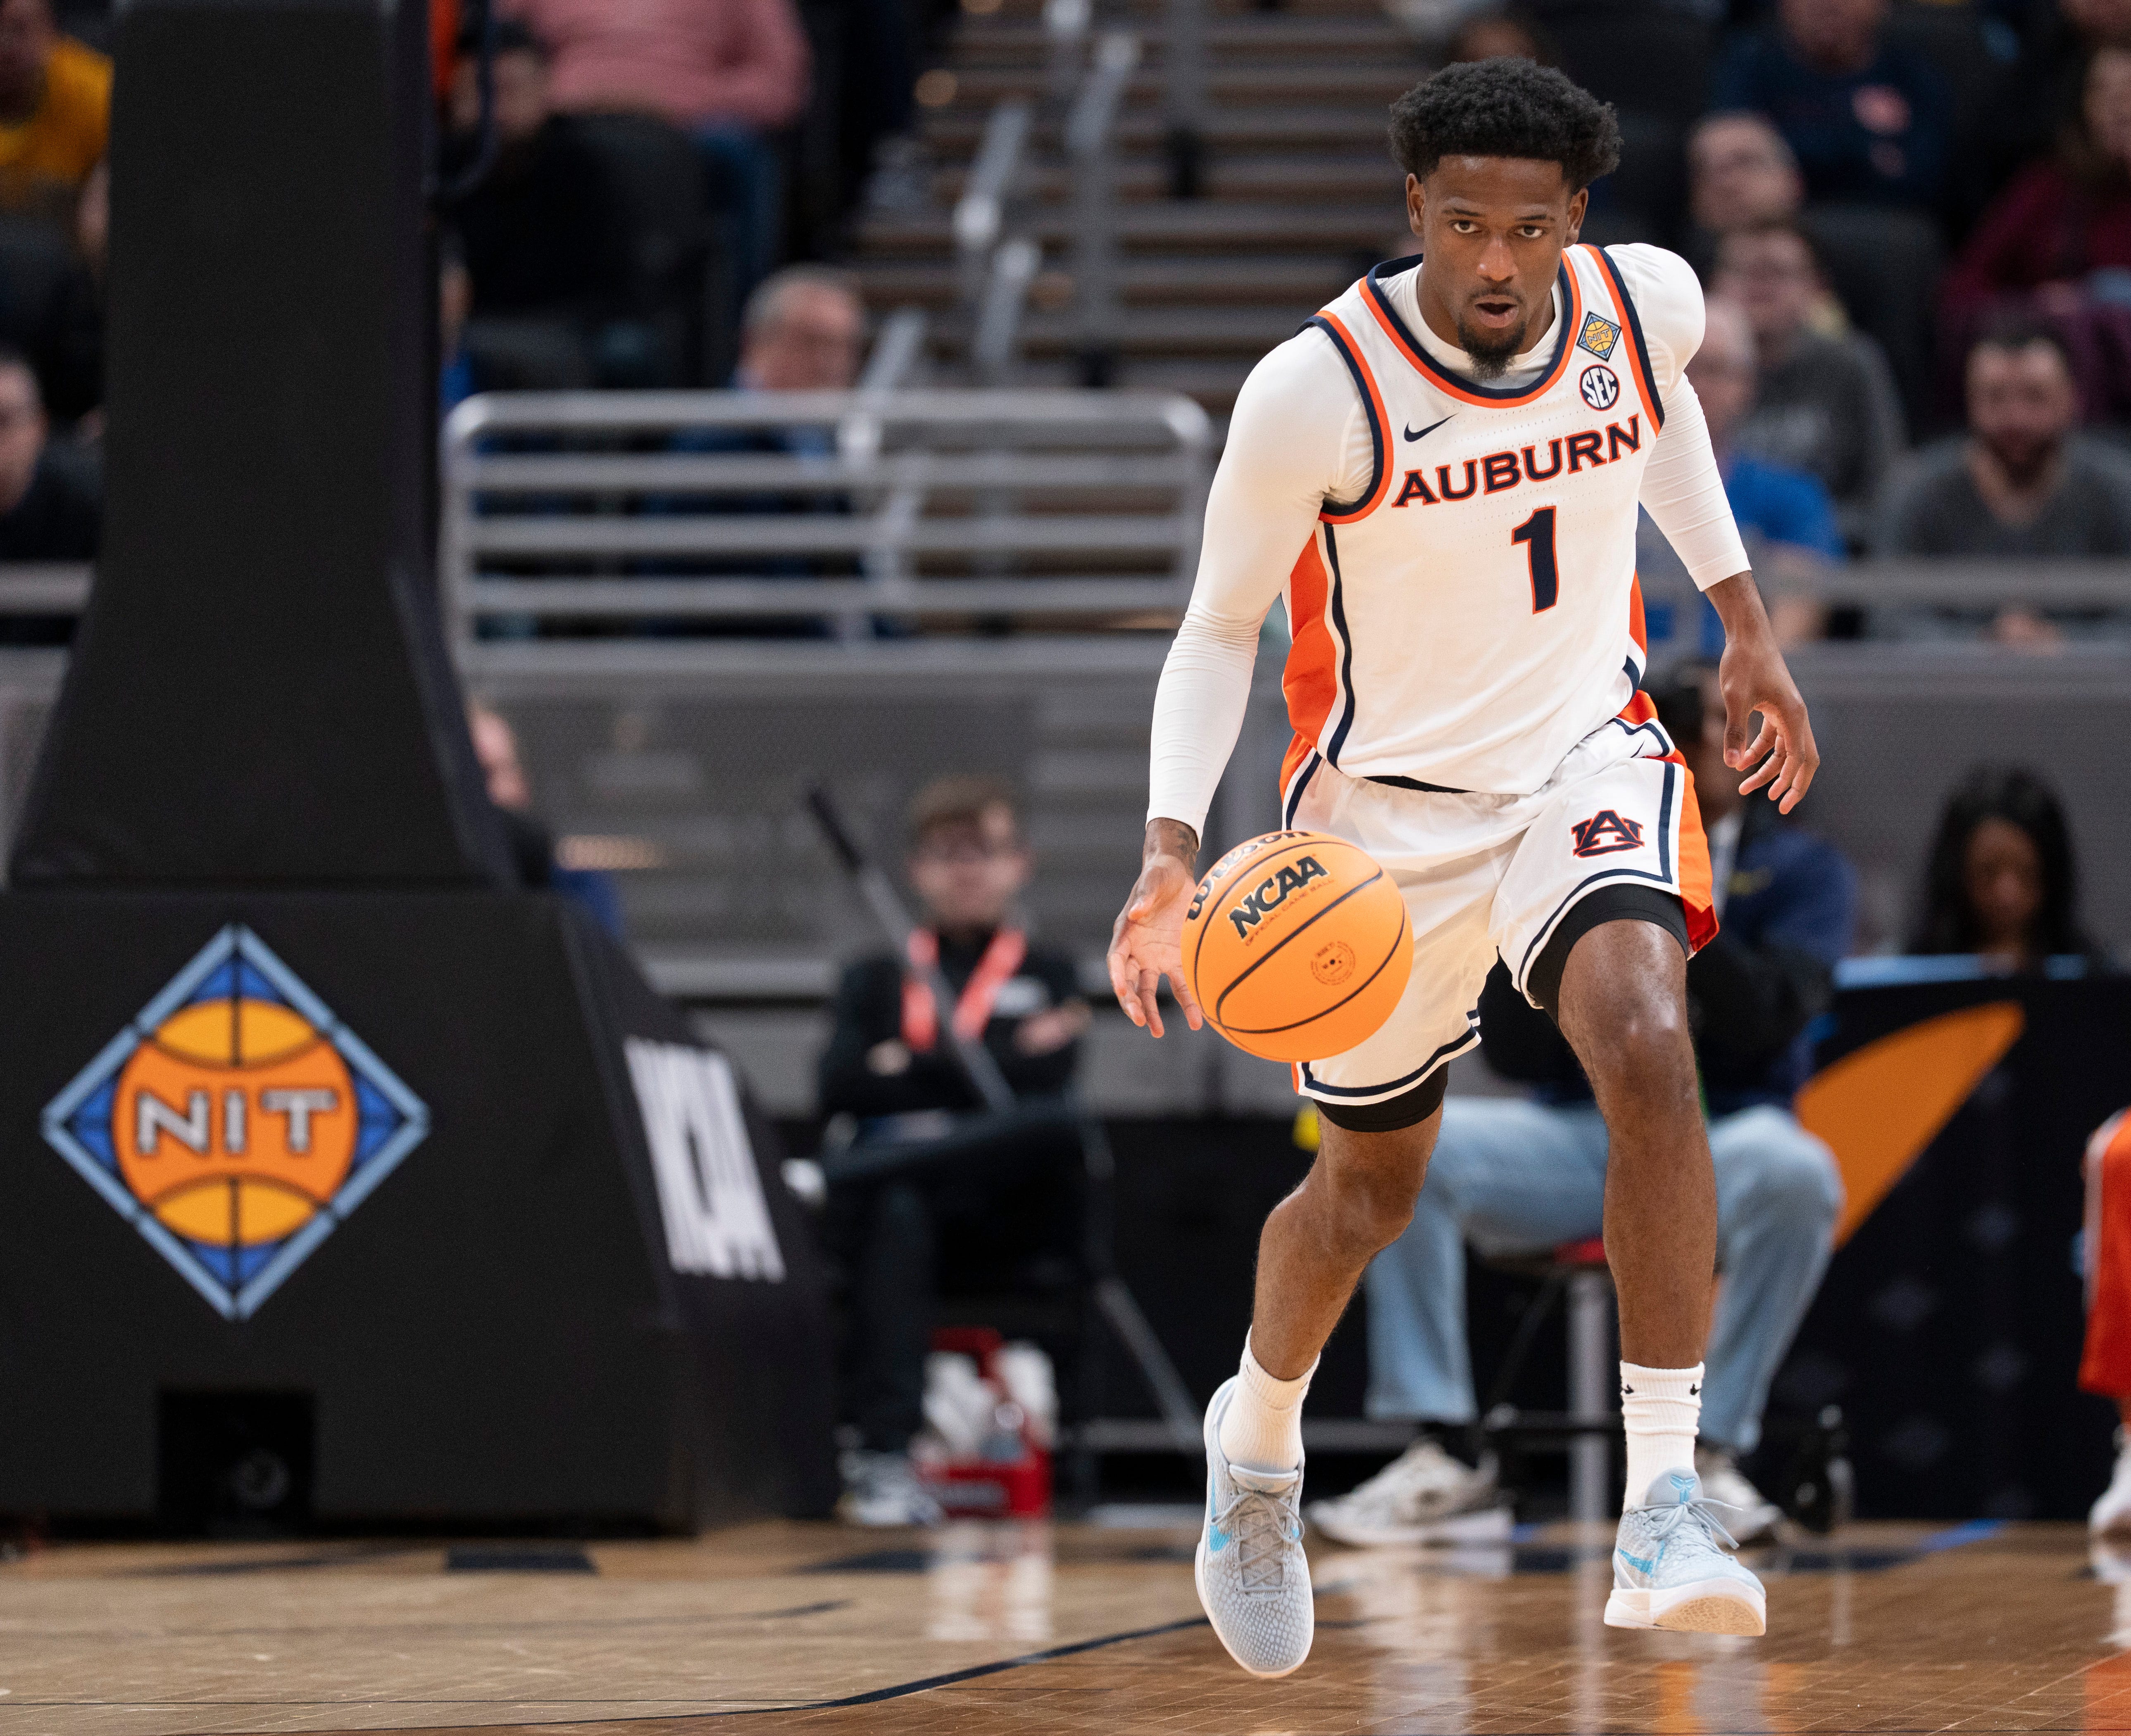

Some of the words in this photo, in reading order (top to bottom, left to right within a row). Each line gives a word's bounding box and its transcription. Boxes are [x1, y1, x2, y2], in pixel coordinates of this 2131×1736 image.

[1588, 328, 1610, 345] NIT
[1582, 367, 1617, 409] SEC
[1391, 413, 1641, 508] AUBURN
[1511, 505, 1560, 615] 1
[1227, 855, 1330, 941] NCAA
[136, 1087, 338, 1156] NIT
